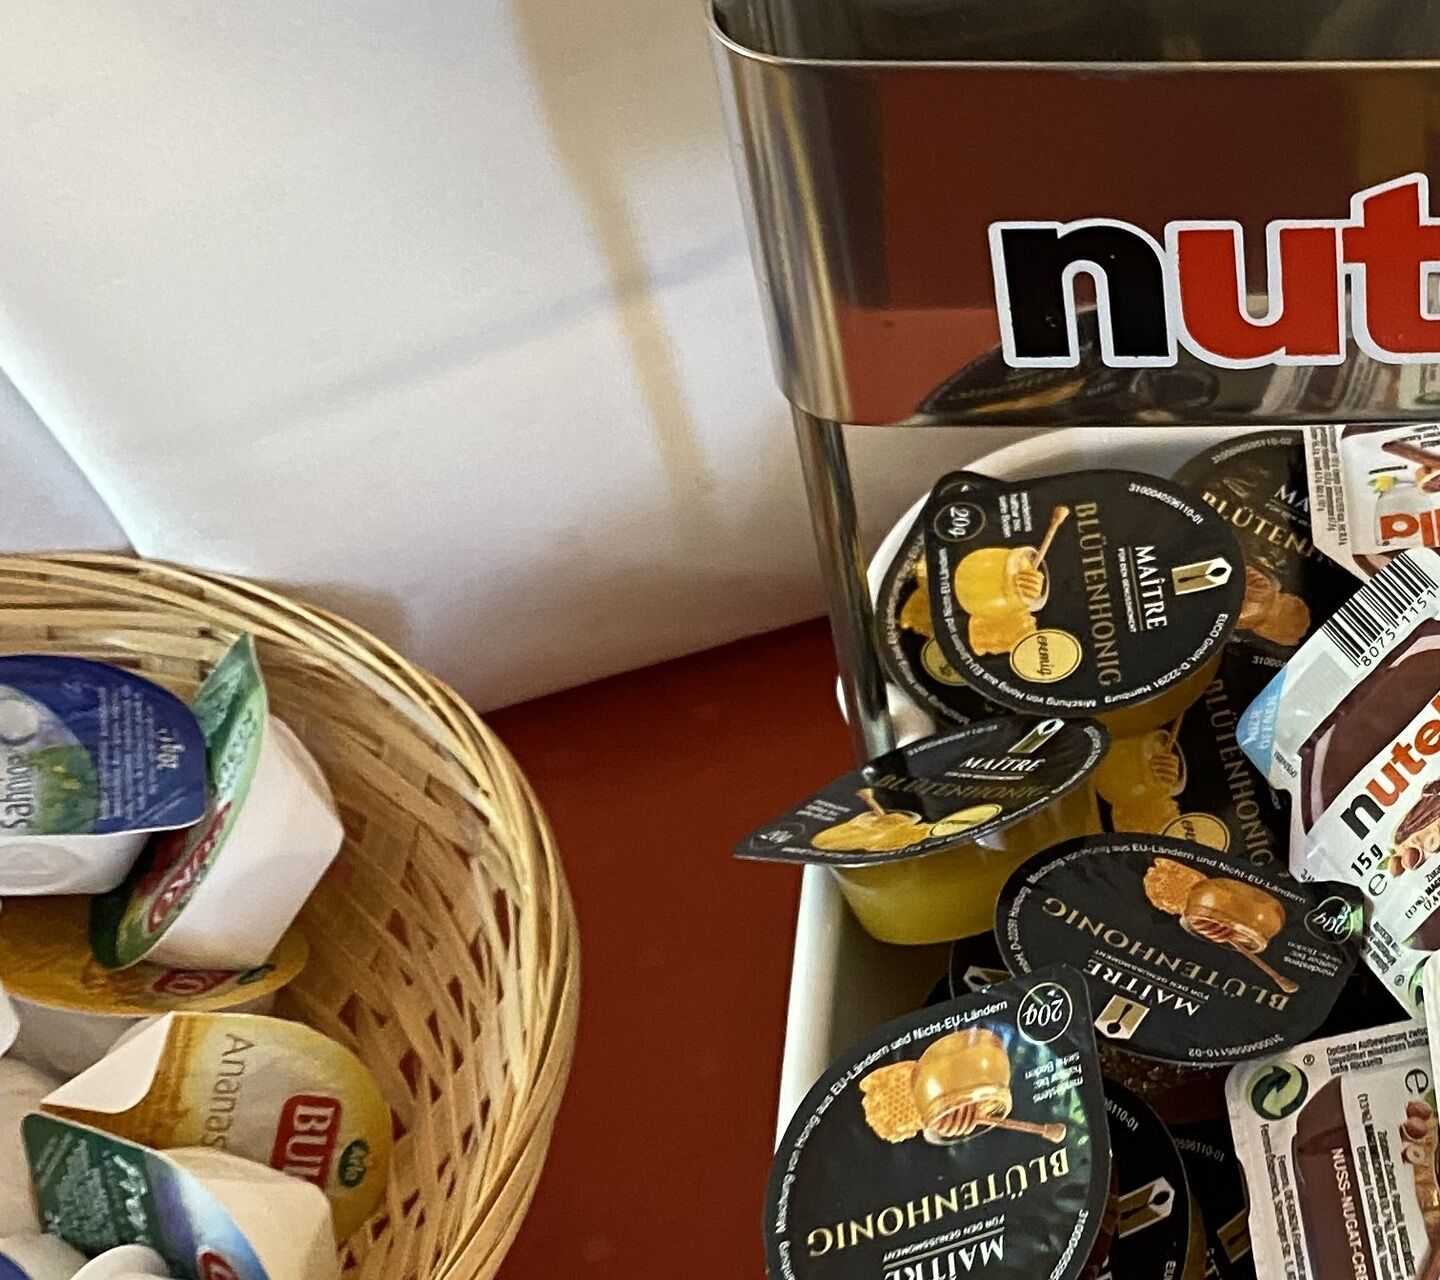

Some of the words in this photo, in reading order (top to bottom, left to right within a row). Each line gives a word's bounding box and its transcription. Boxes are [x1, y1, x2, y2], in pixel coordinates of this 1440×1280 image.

[947, 505, 971, 539] 20g
[1074, 501, 1122, 686] BLÜTENHONIG
[1133, 544, 1169, 631] MAÎTRE
[1361, 628, 1396, 667] 8075
[1401, 588, 1439, 625] 1151
[959, 755, 1047, 773] MAÎTRE
[1040, 896, 1292, 1013] BLÜTENHONIG
[1082, 957, 1202, 1018] MAÎTRE
[912, 1000, 1008, 1041] Nicht-EU-Ländern
[1020, 997, 1065, 1029] 20g
[204, 1033, 256, 1149] Ananas
[805, 1147, 1072, 1258] BLÜTENHONIG
